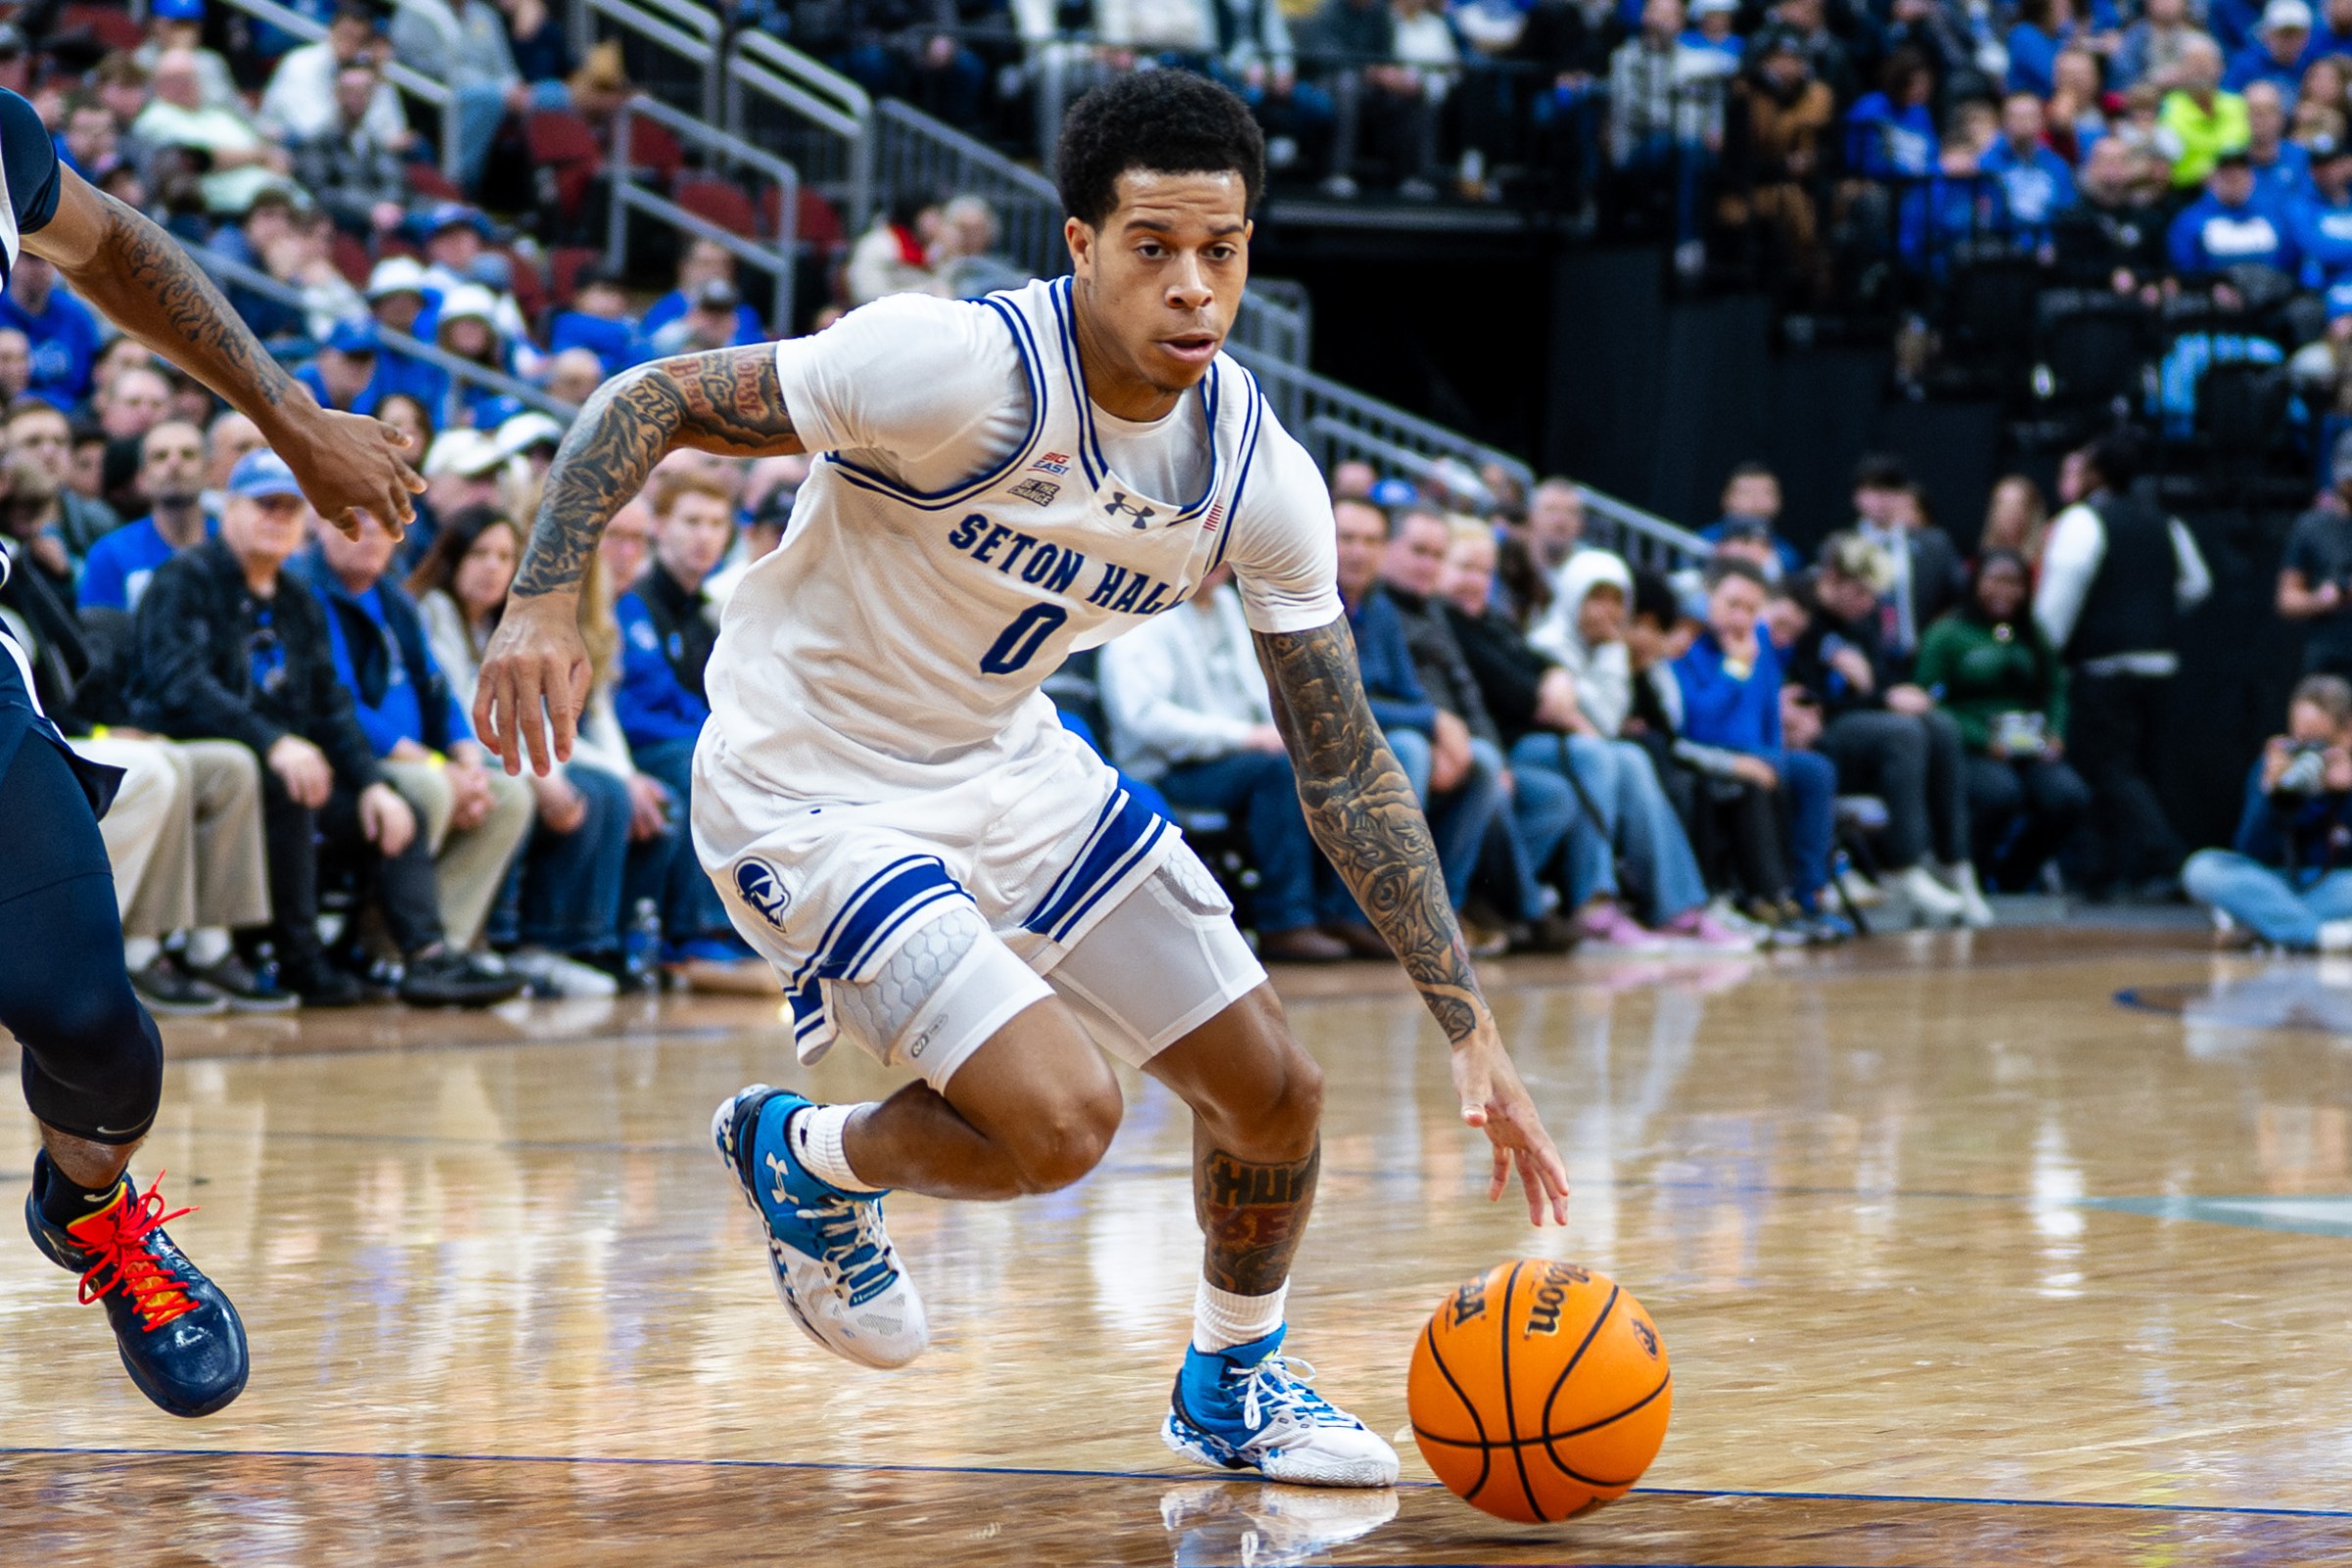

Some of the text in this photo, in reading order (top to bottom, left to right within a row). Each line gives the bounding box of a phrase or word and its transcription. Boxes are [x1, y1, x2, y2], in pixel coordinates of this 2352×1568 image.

[1032, 460, 1070, 475] EAST
[1042, 452, 1070, 465] BIG
[948, 514, 1086, 597] SETON
[980, 602, 1067, 675] 0
